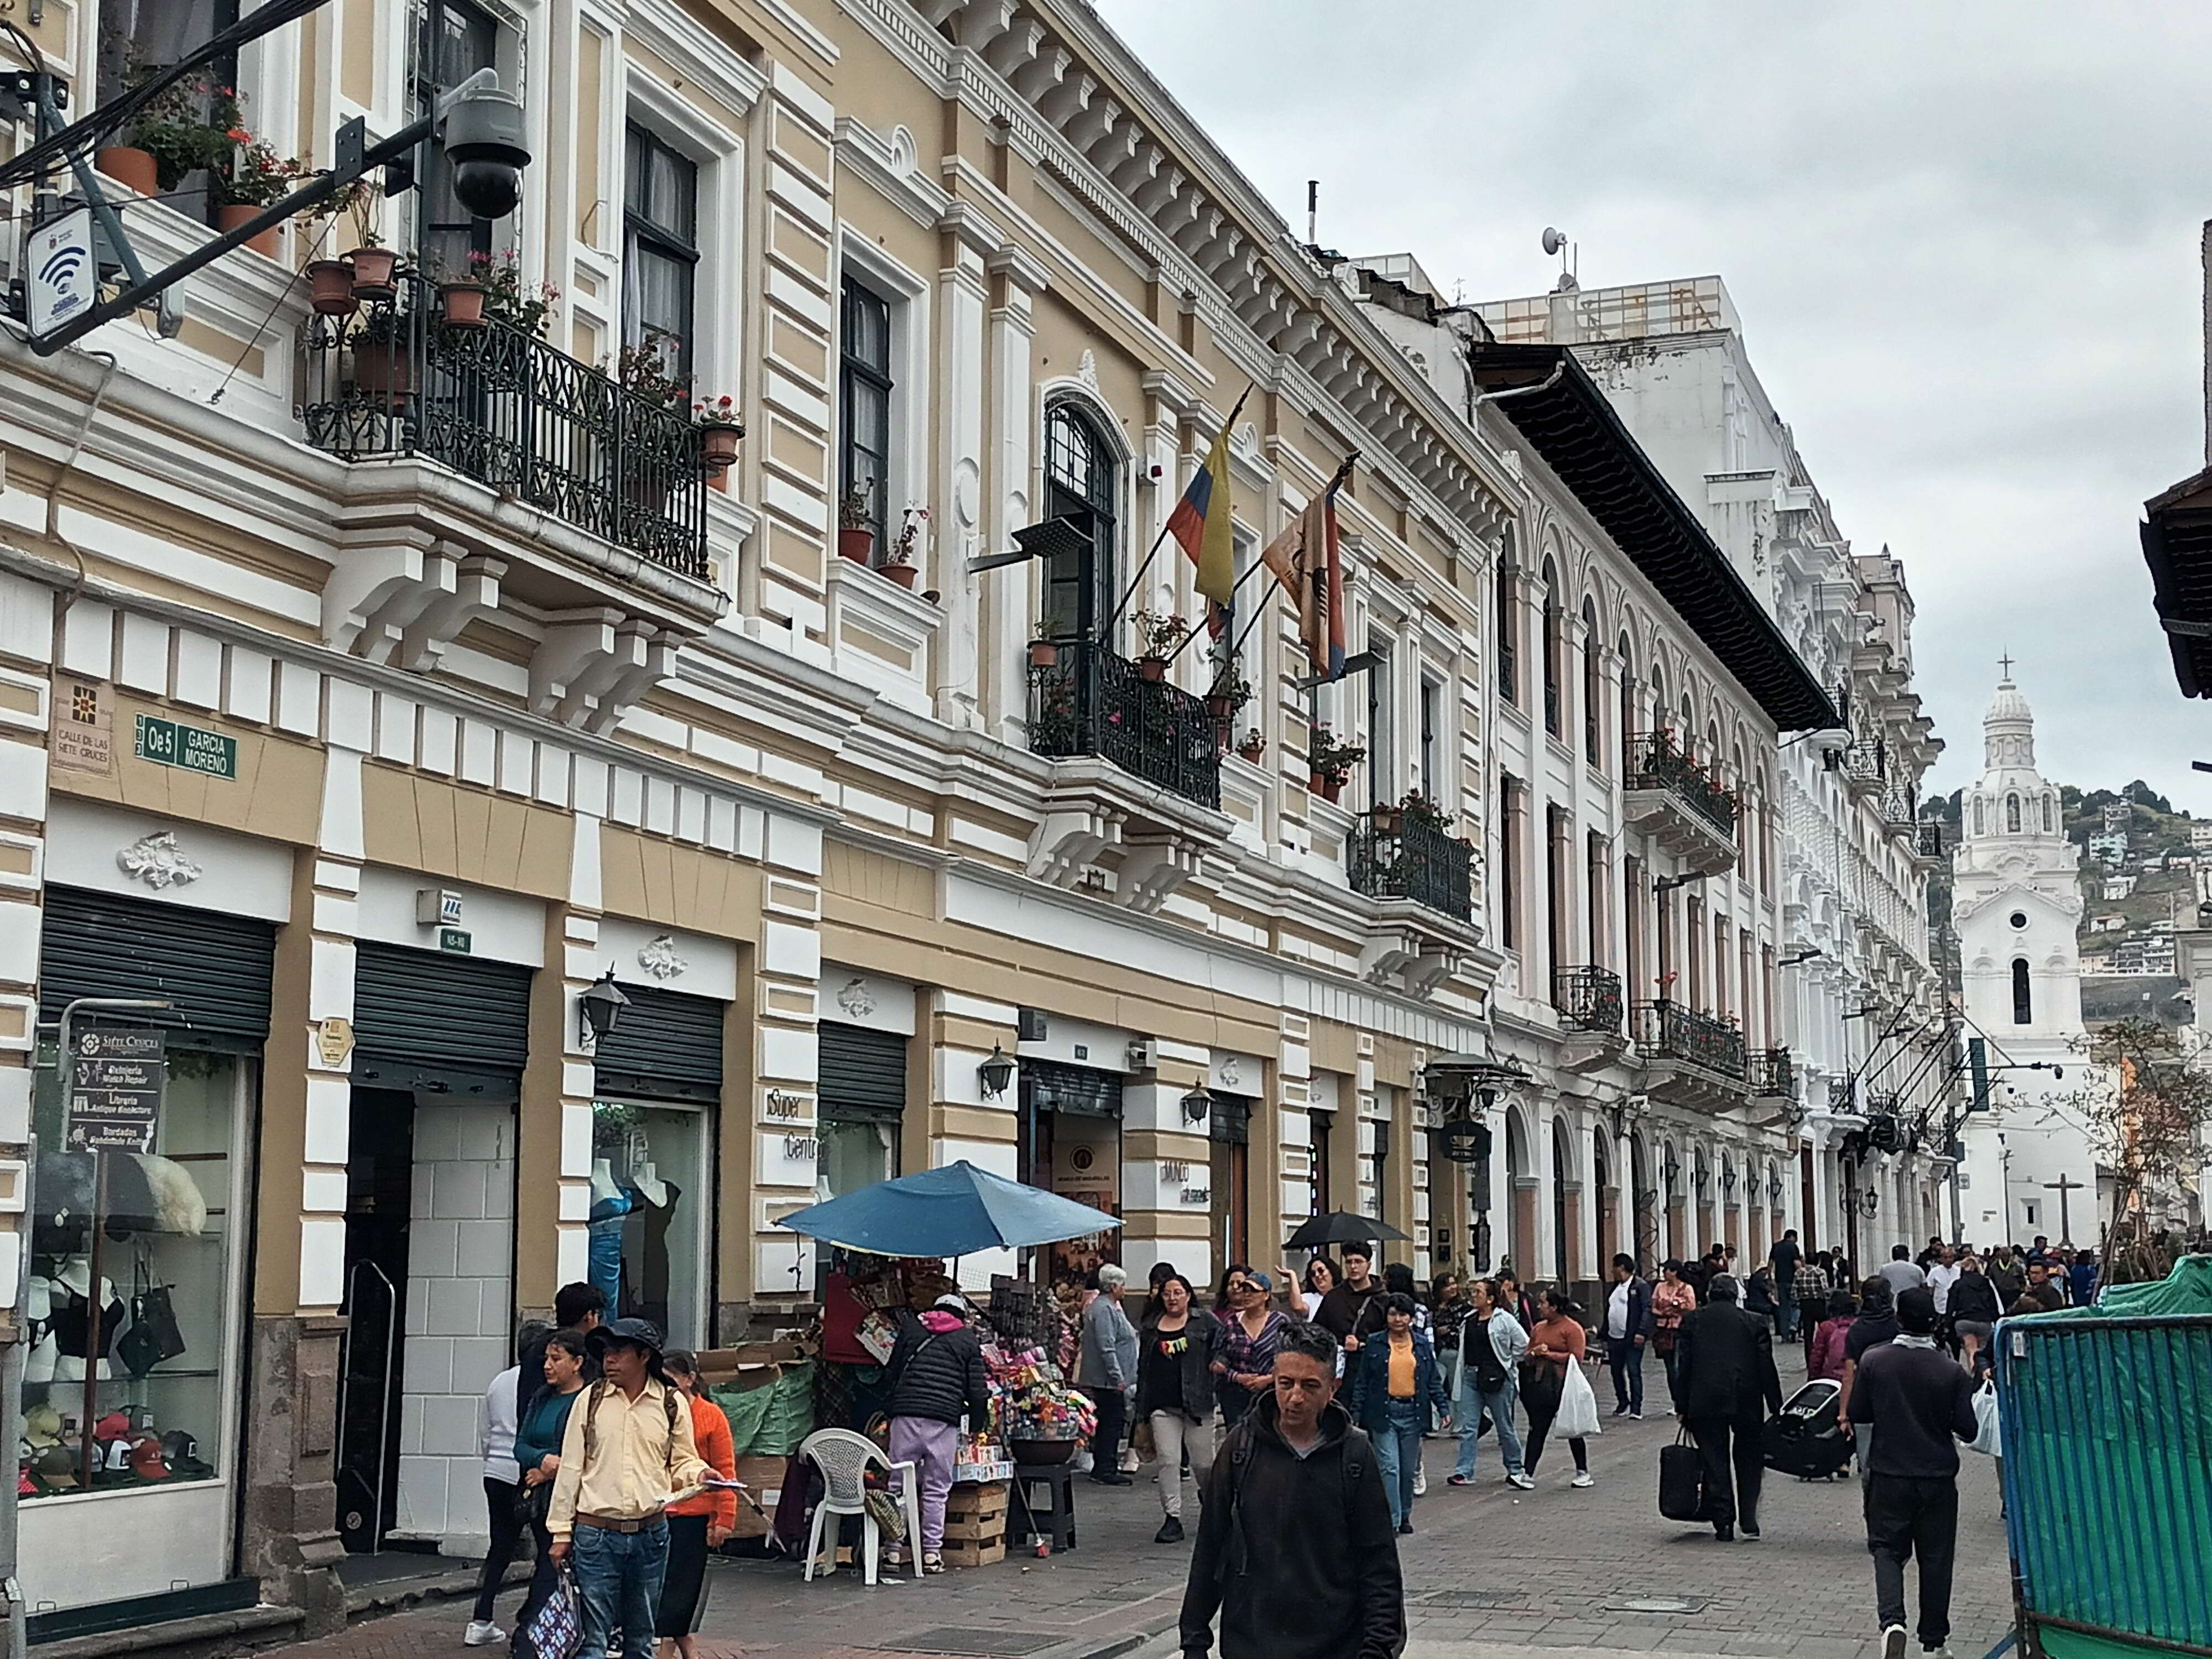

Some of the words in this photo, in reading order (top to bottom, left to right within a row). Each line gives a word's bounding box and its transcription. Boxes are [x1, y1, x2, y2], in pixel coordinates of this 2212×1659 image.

[59, 729, 81, 744] CALLE
[83, 735, 93, 747] DE
[94, 738, 108, 750] LAS
[188, 731, 226, 755] GARCIA
[58, 742, 77, 755] SIETE
[80, 748, 108, 763] CRUCES
[185, 748, 227, 774] MORENO
[766, 1088, 800, 1122] Super
